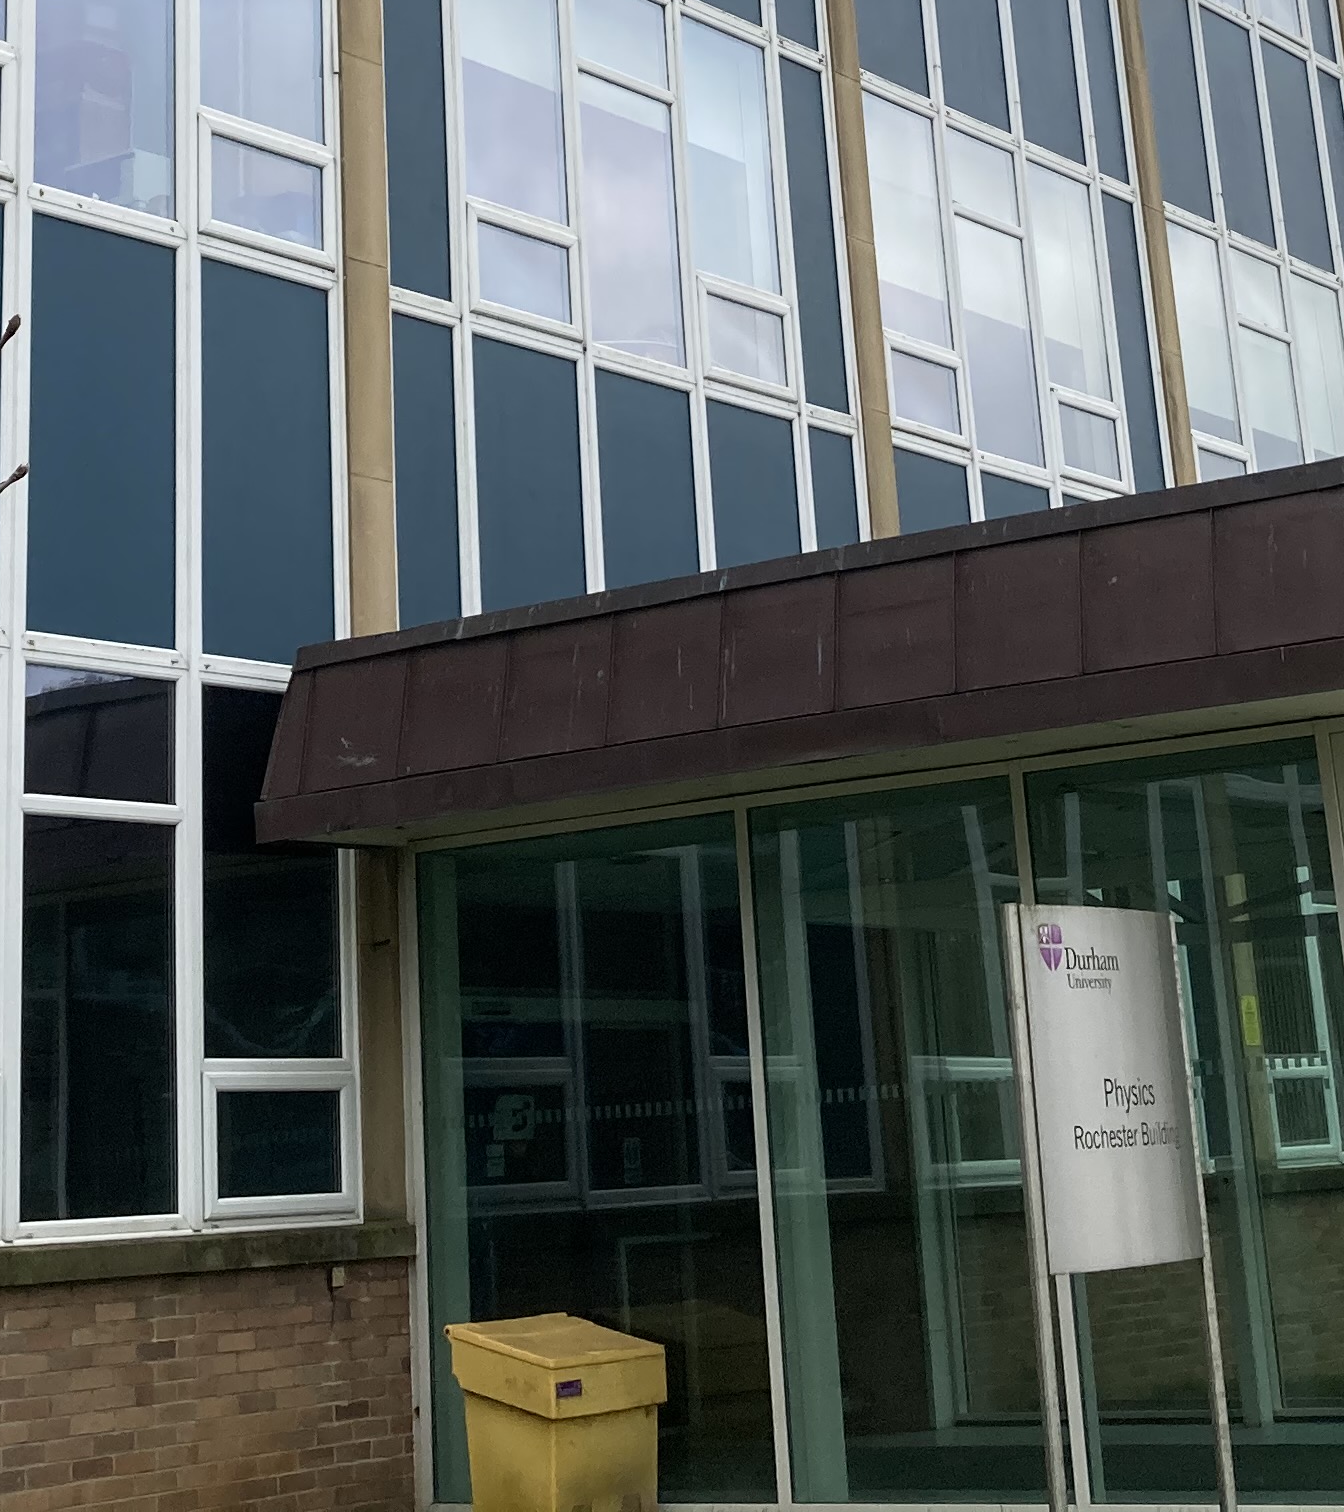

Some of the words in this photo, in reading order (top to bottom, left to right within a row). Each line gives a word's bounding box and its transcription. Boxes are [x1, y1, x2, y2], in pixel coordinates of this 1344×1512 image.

[1064, 946, 1120, 972] Durham
[1067, 973, 1112, 995] University
[1103, 1077, 1155, 1114] Physics
[1074, 1124, 1138, 1150] Rochester
[1140, 1121, 1180, 1150] Building
